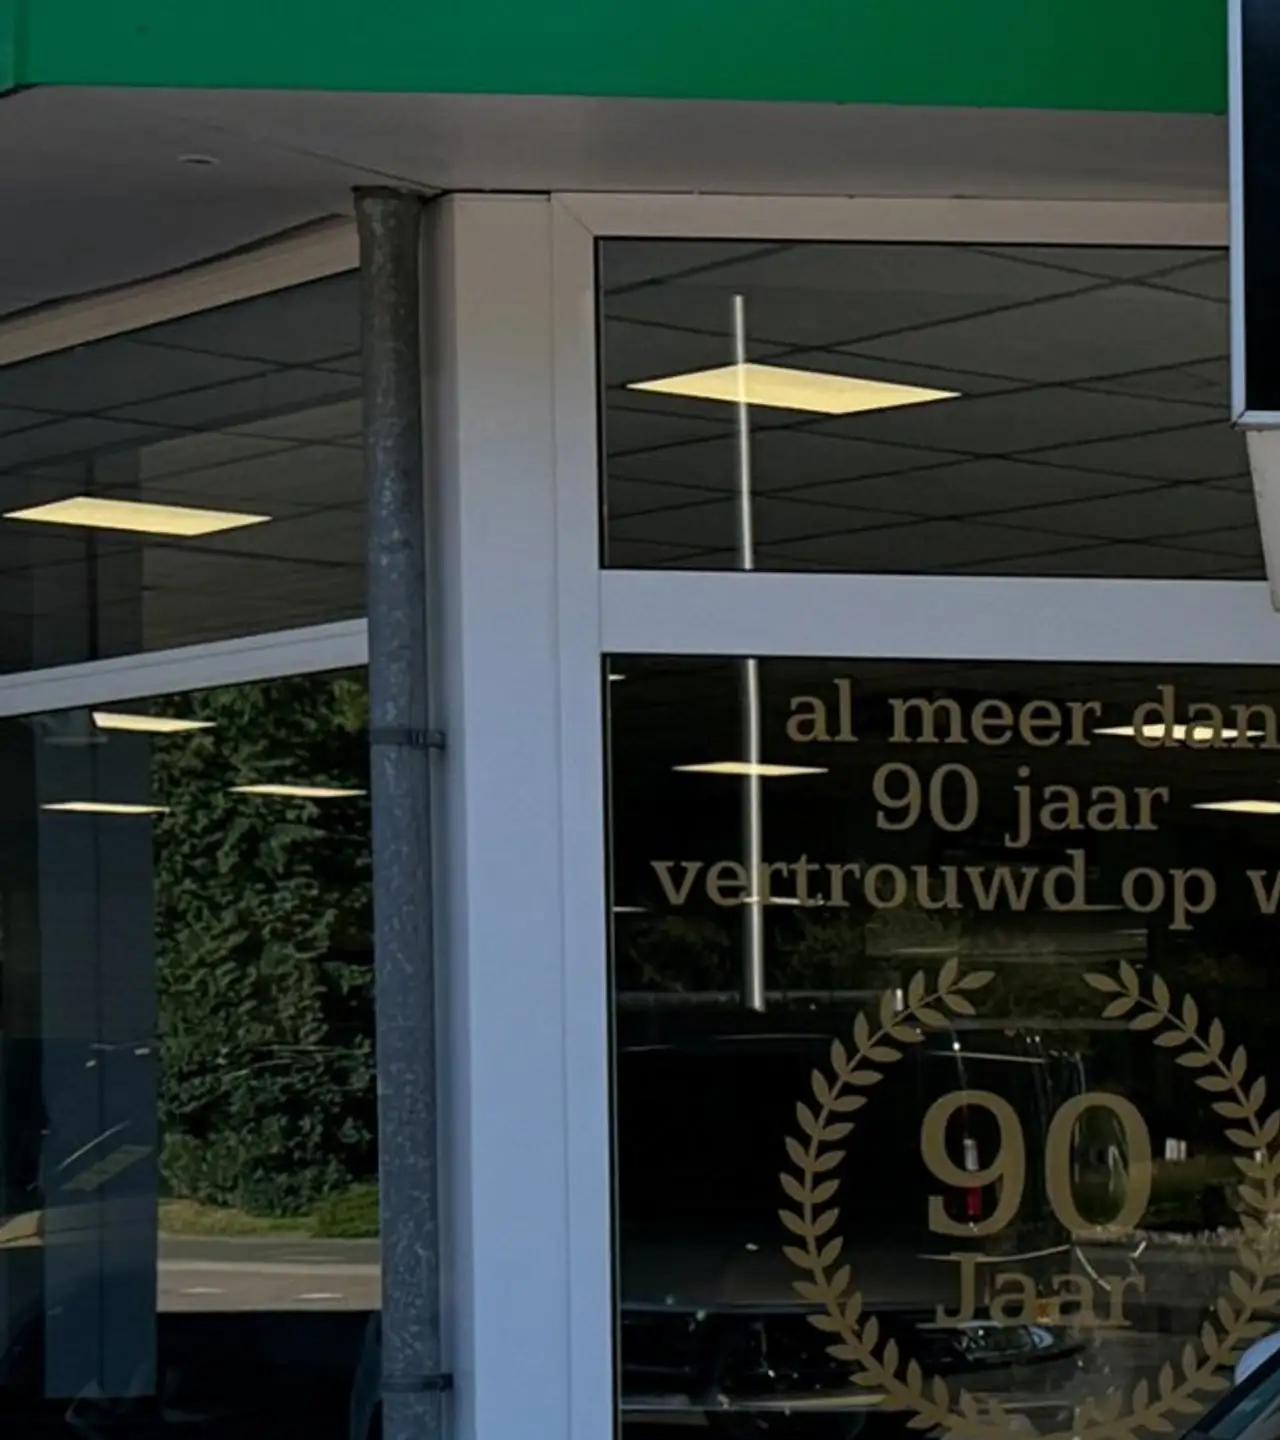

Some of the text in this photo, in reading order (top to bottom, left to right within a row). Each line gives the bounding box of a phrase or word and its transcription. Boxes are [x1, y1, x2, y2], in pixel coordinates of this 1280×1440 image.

[786, 679, 858, 744] al
[888, 693, 1101, 746] meer
[872, 762, 1170, 847] 90 jaar
[651, 849, 1085, 914] vertrouwd
[1121, 863, 1216, 928] op
[920, 1091, 1151, 1236] 90
[935, 1252, 1148, 1328] Jaar
